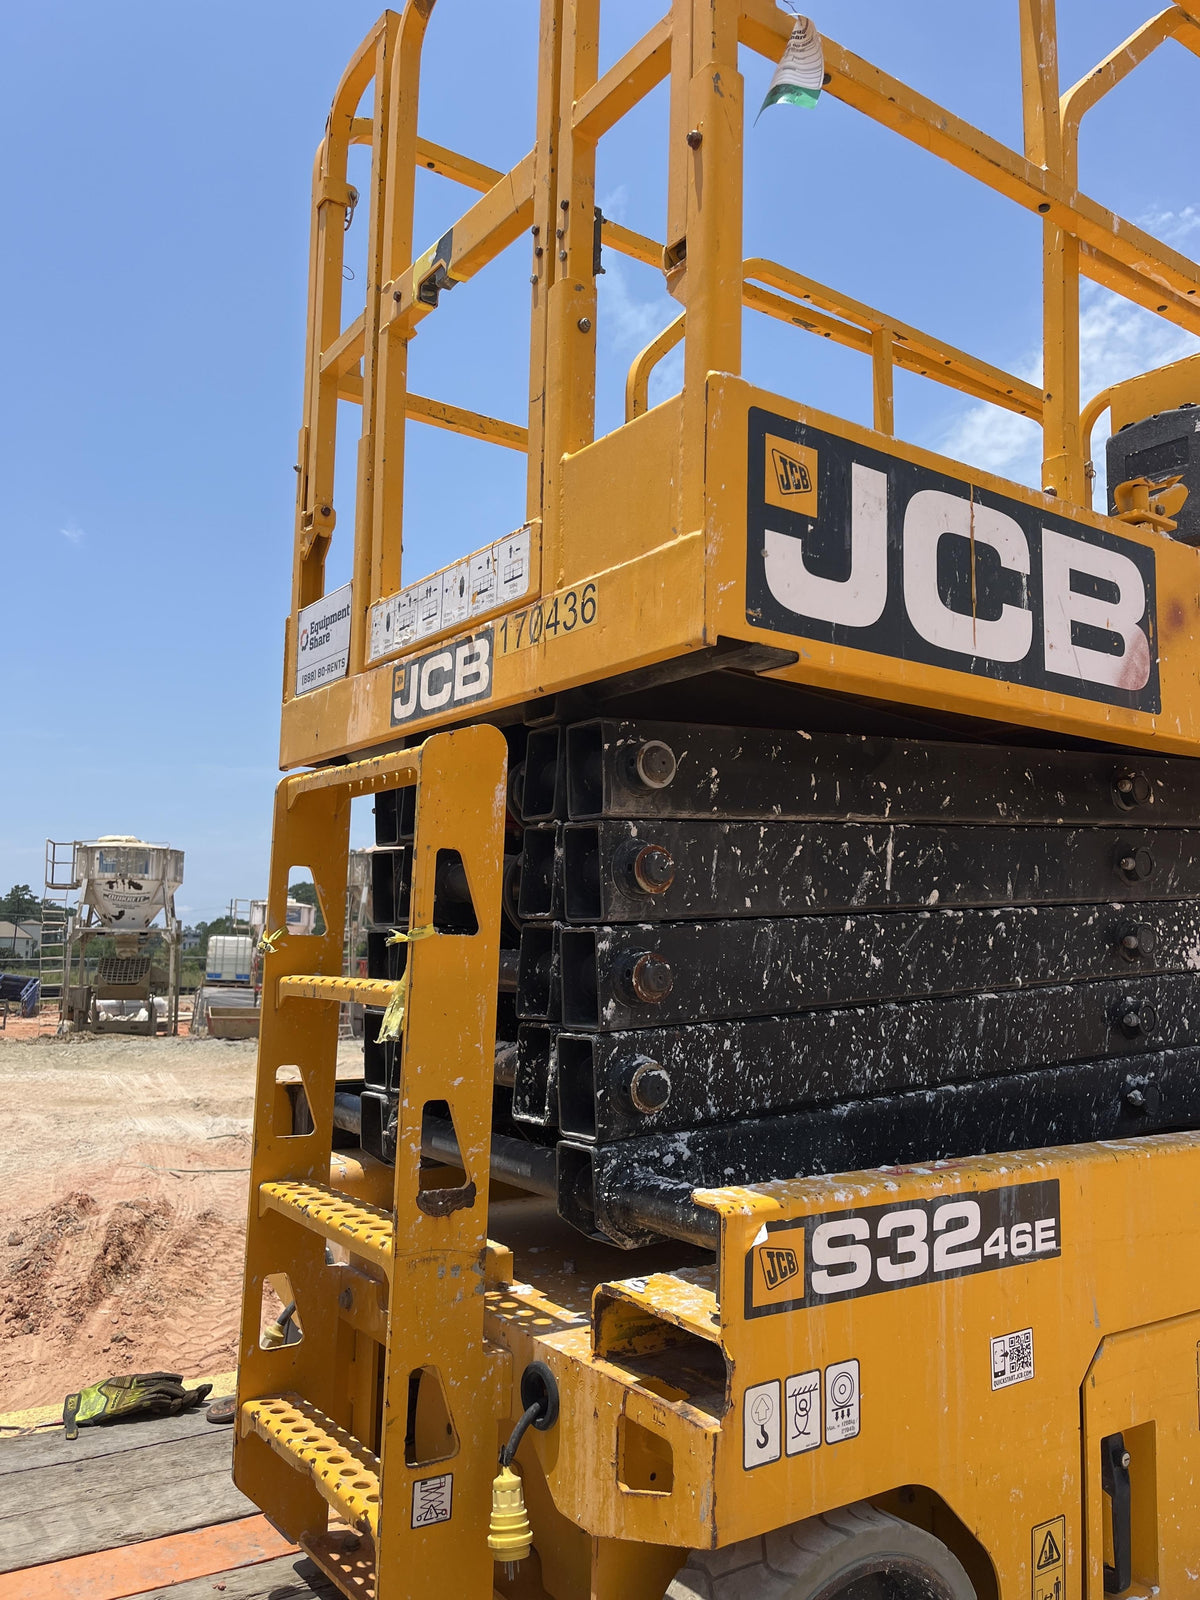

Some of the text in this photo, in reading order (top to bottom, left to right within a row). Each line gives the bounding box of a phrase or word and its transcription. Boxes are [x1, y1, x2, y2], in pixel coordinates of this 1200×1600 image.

[778, 456, 812, 492] JCB
[764, 462, 1151, 691] JCB
[310, 604, 350, 635] Equipment
[500, 583, 597, 653] 170436
[309, 632, 330, 650] Share
[393, 637, 490, 720] JCB
[765, 1250, 798, 1286] JCB
